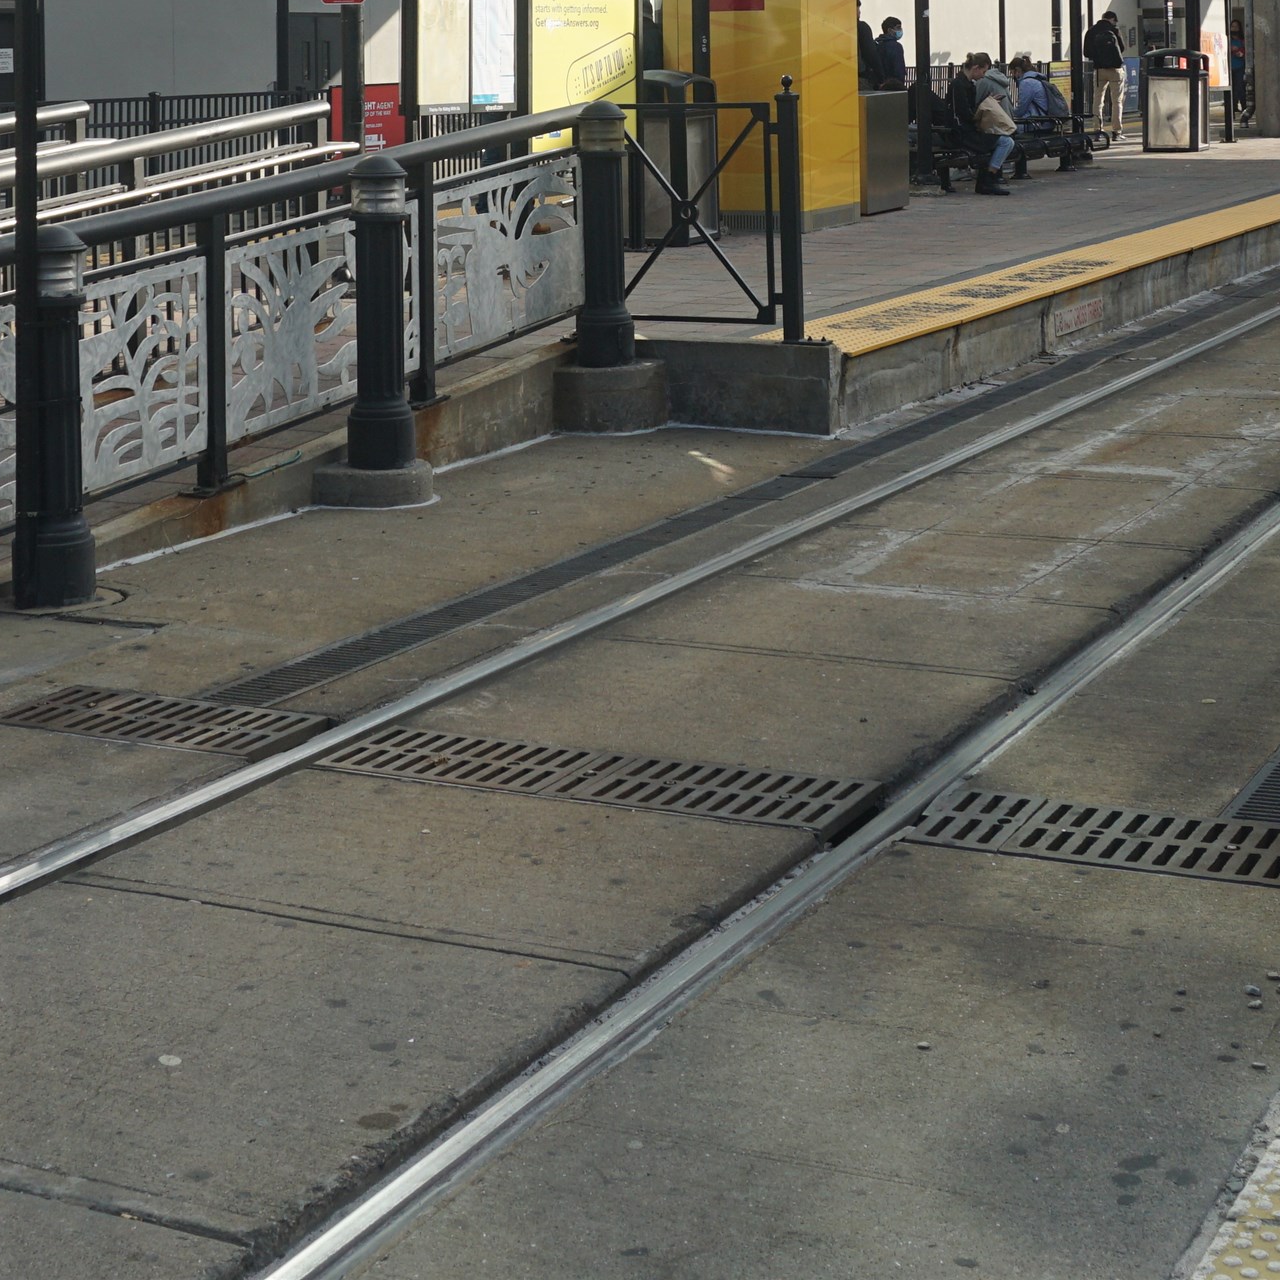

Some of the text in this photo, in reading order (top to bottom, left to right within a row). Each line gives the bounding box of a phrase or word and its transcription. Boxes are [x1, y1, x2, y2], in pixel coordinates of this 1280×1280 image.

[535, 4, 608, 16] starts with getting informed.
[535, 18, 600, 30] GeteAnswers.org
[582, 48, 625, 89] IT'S UP TO YOU
[376, 101, 394, 110] AGENT
